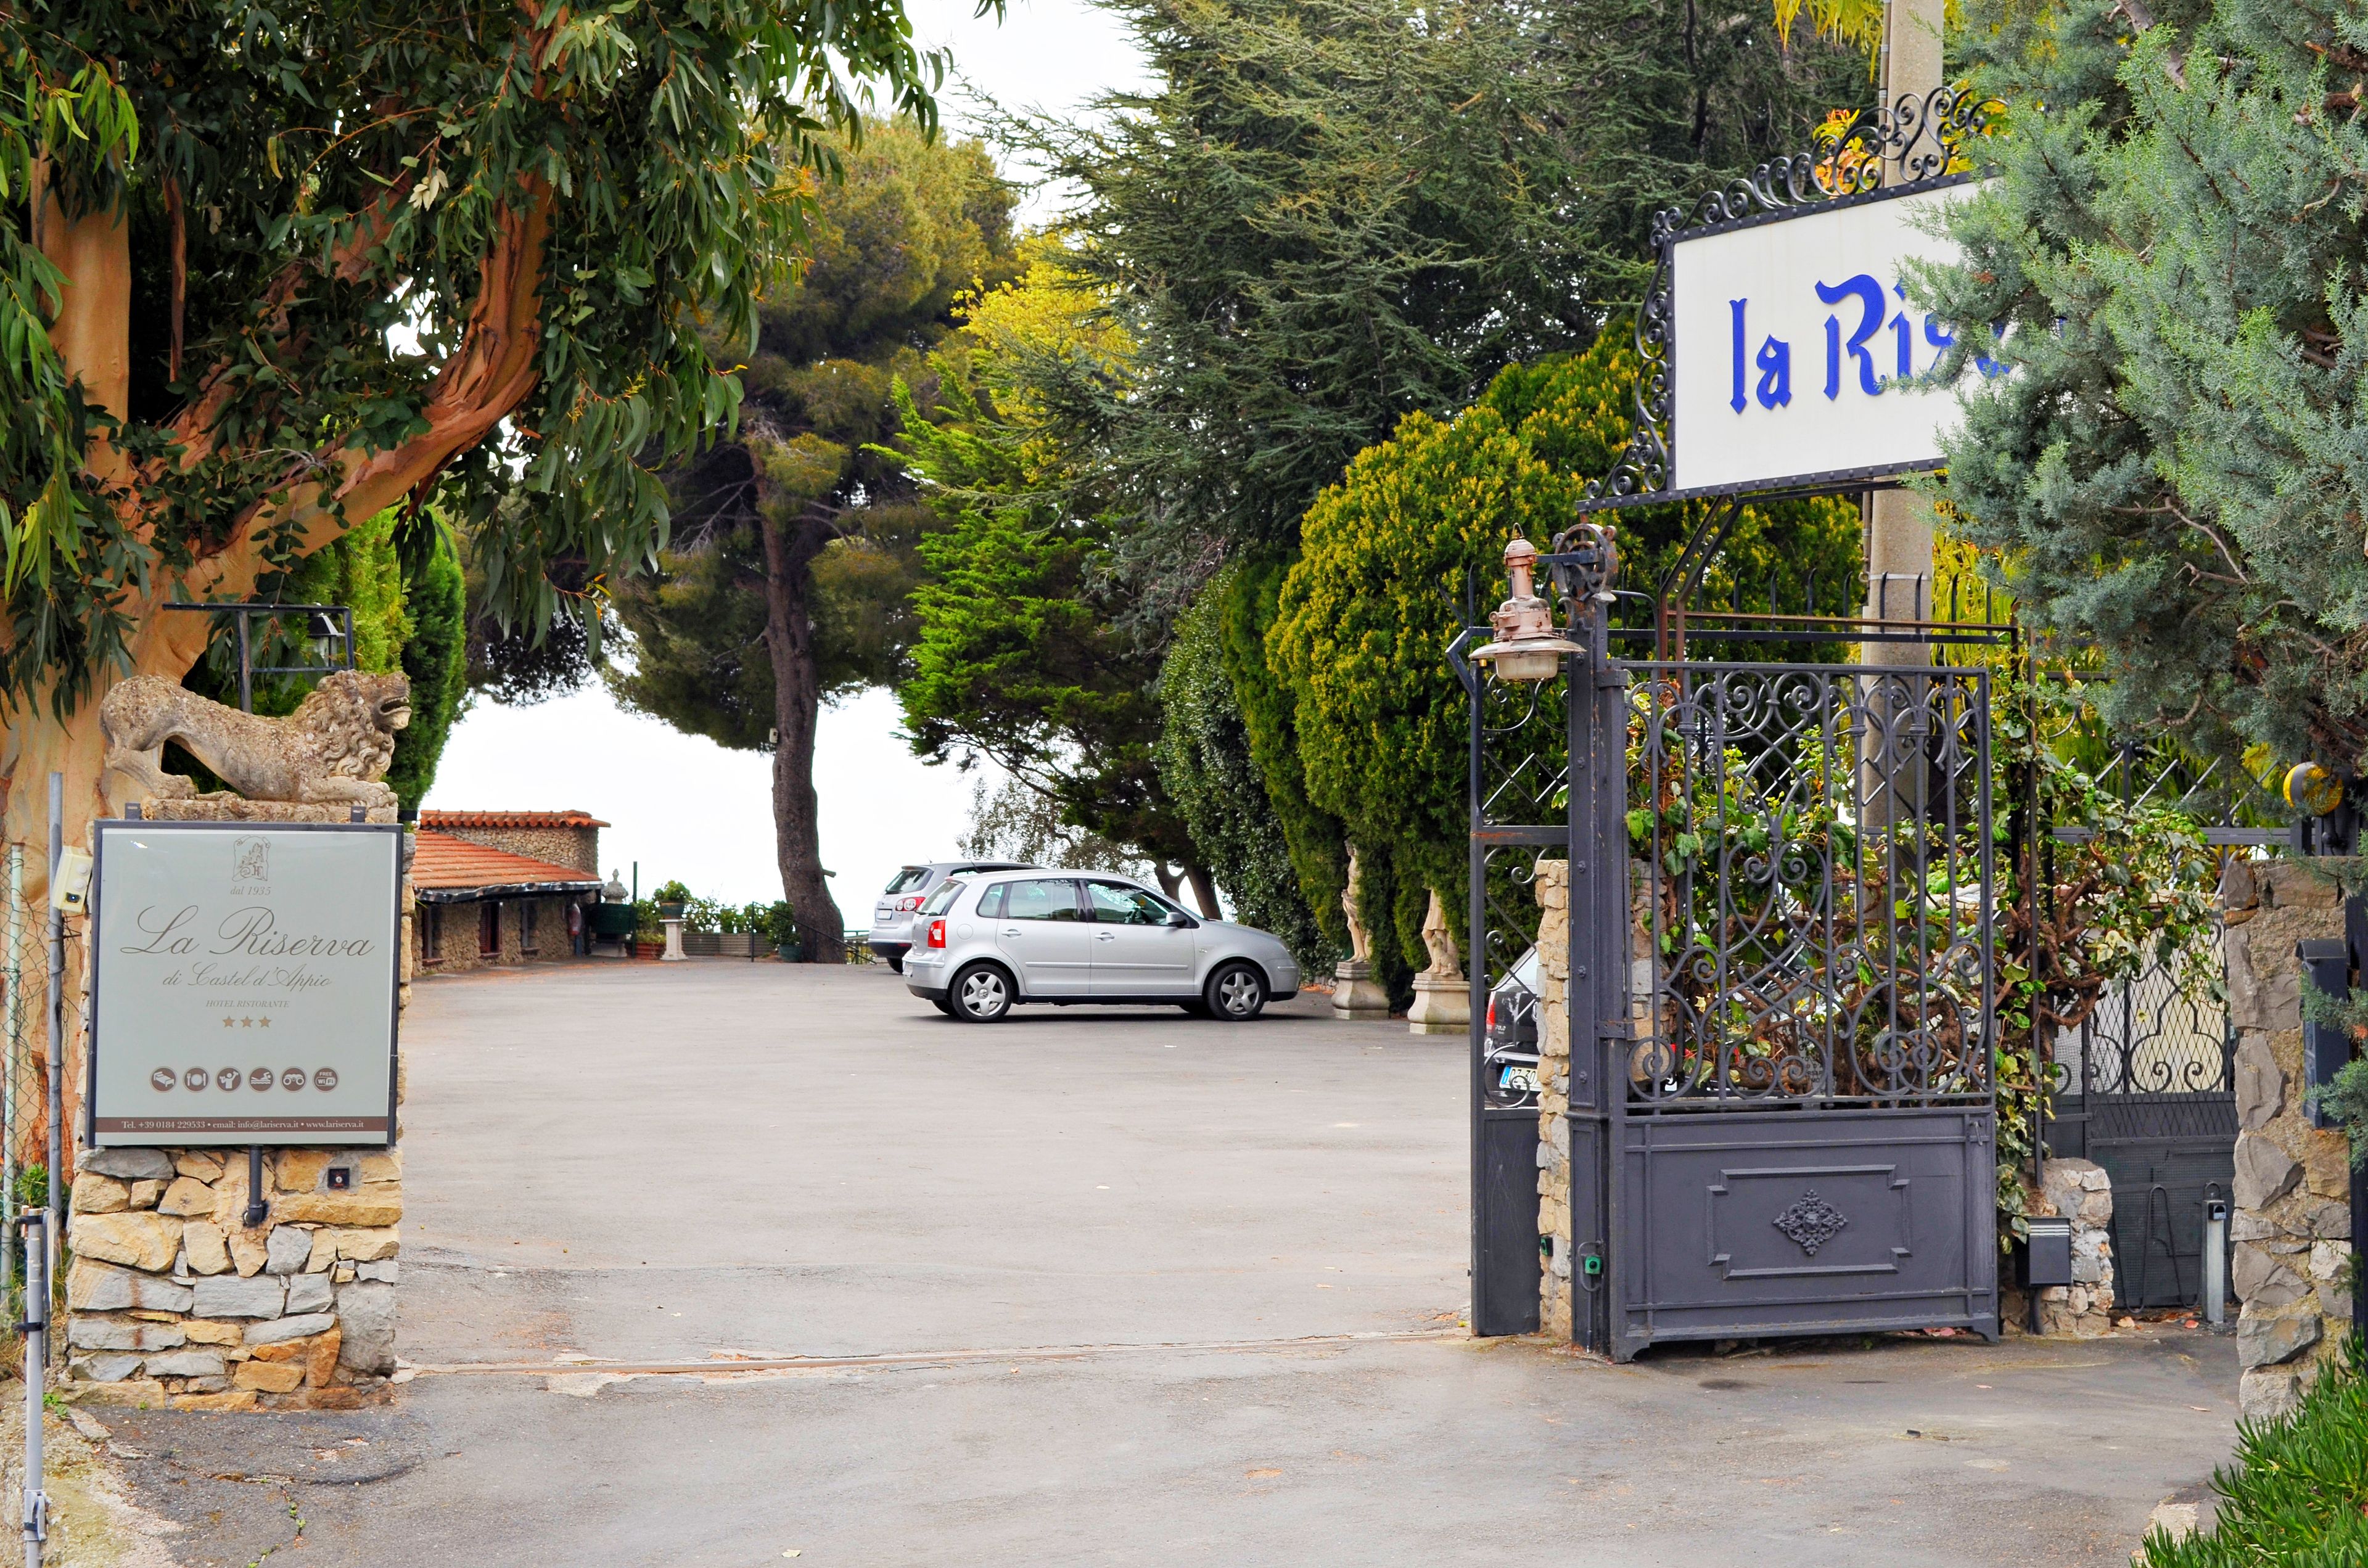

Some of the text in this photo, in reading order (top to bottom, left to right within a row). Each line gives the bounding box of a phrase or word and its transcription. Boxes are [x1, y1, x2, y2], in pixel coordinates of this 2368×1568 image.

[1729, 298, 1792, 415] la
[230, 886, 272, 896] dal 1935
[120, 905, 376, 956] La Riserva
[162, 962, 333, 992] di Castel d'Appio
[205, 999, 290, 1008] HOTEL RISTORANTE
[121, 1119, 364, 1130] Tel. +39 0184 229533 email: info@lariserva.it www.lariserva.it
